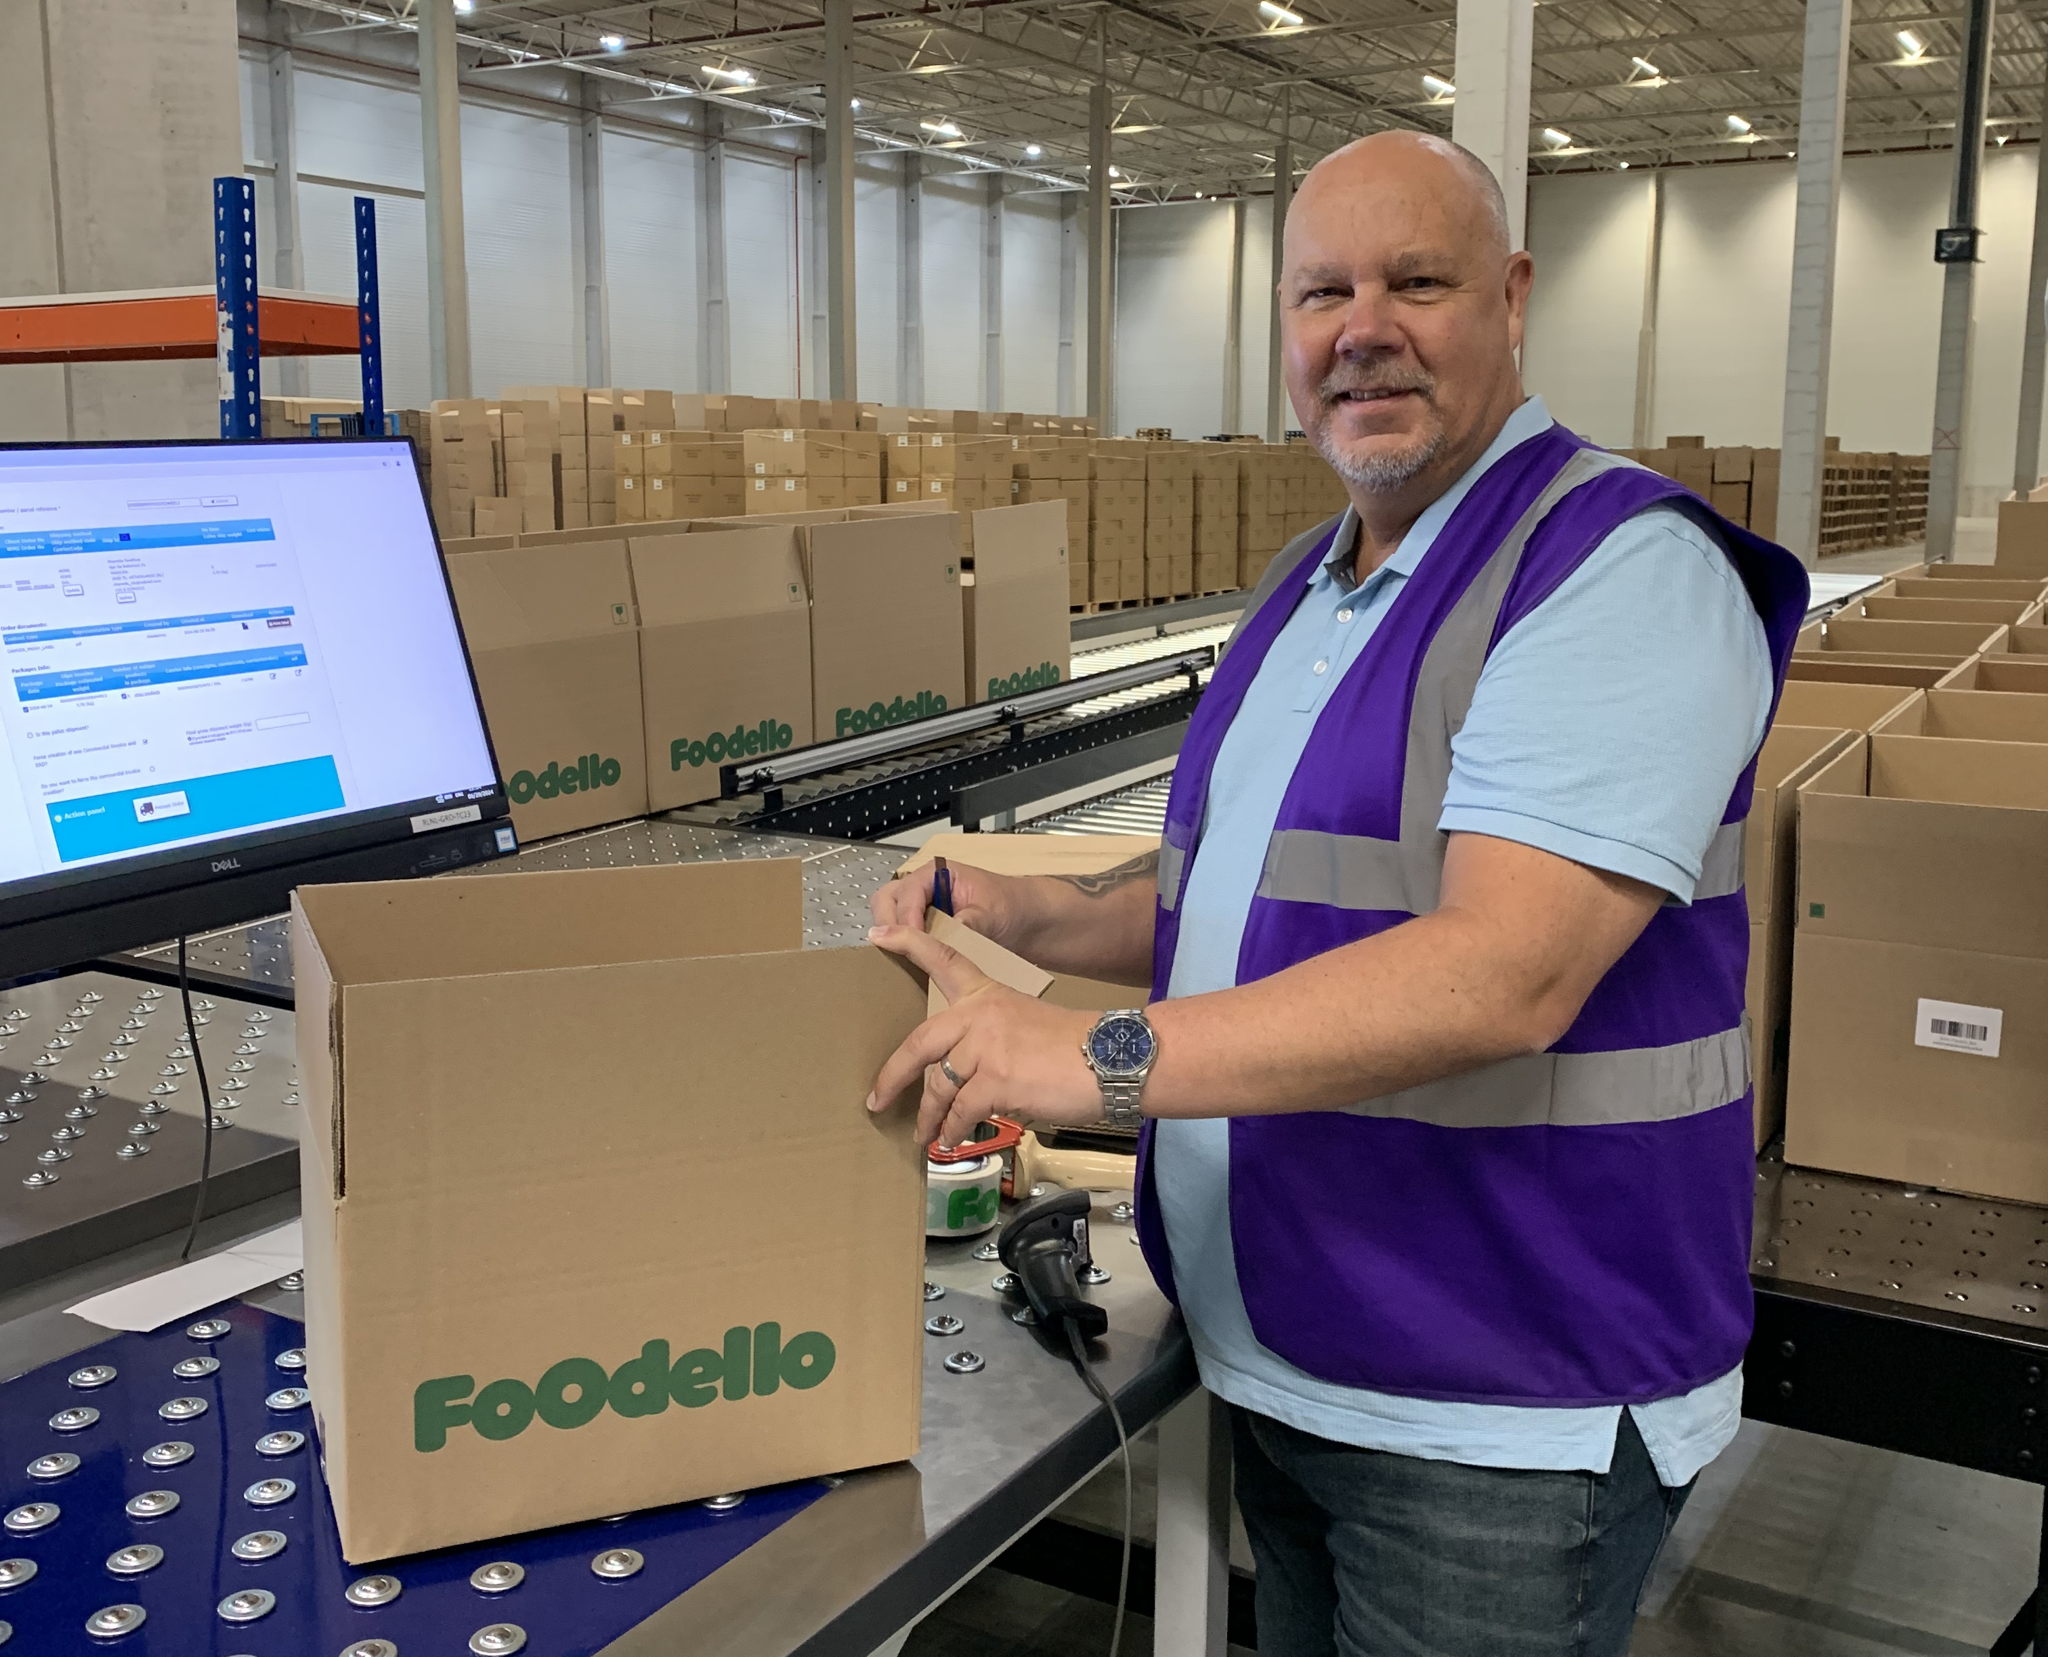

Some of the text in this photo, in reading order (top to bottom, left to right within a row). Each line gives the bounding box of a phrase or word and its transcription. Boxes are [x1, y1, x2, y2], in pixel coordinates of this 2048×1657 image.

[64, 806, 106, 820] Action panel
[211, 857, 241, 873] DELL
